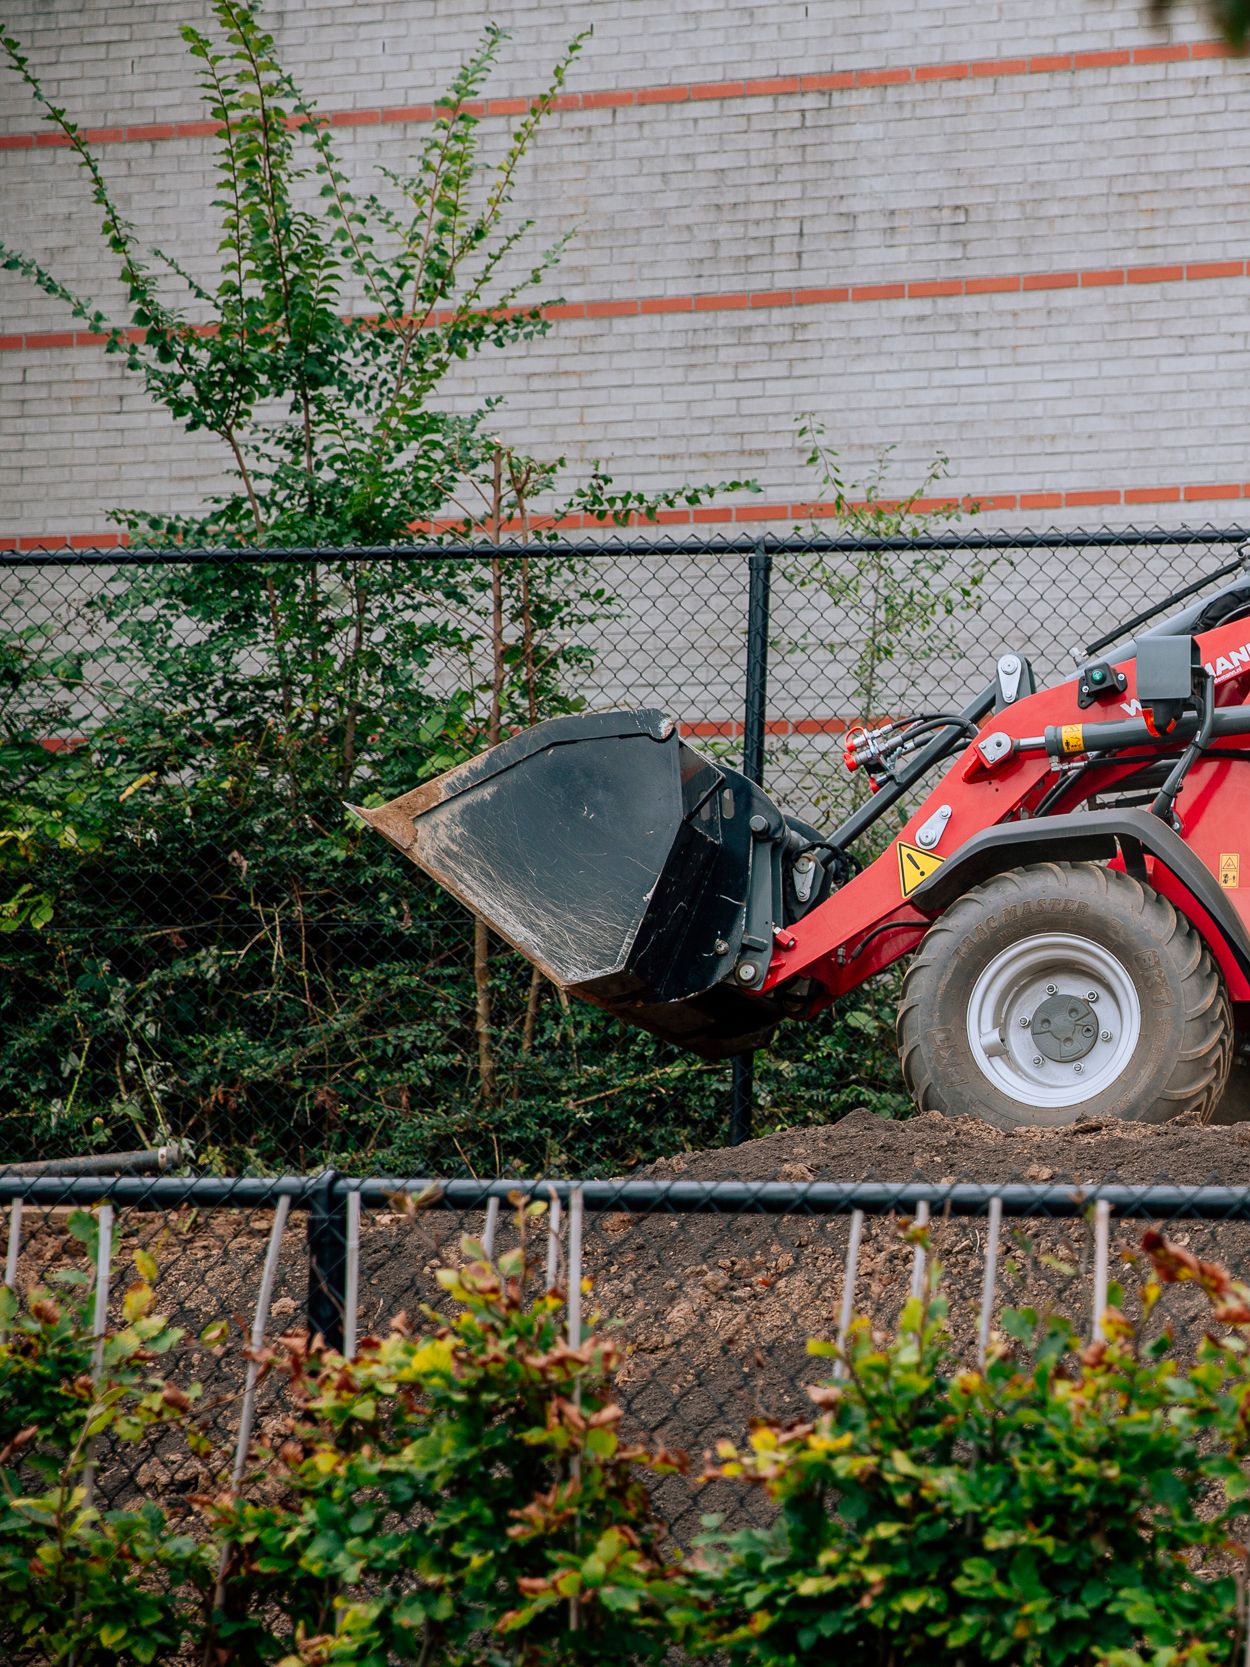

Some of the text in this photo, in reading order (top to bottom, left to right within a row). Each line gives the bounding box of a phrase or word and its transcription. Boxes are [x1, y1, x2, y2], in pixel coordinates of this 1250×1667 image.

[950, 915, 997, 958] TRAC
[1002, 898, 1089, 921] MASTER
[1133, 948, 1176, 1009] BKT
